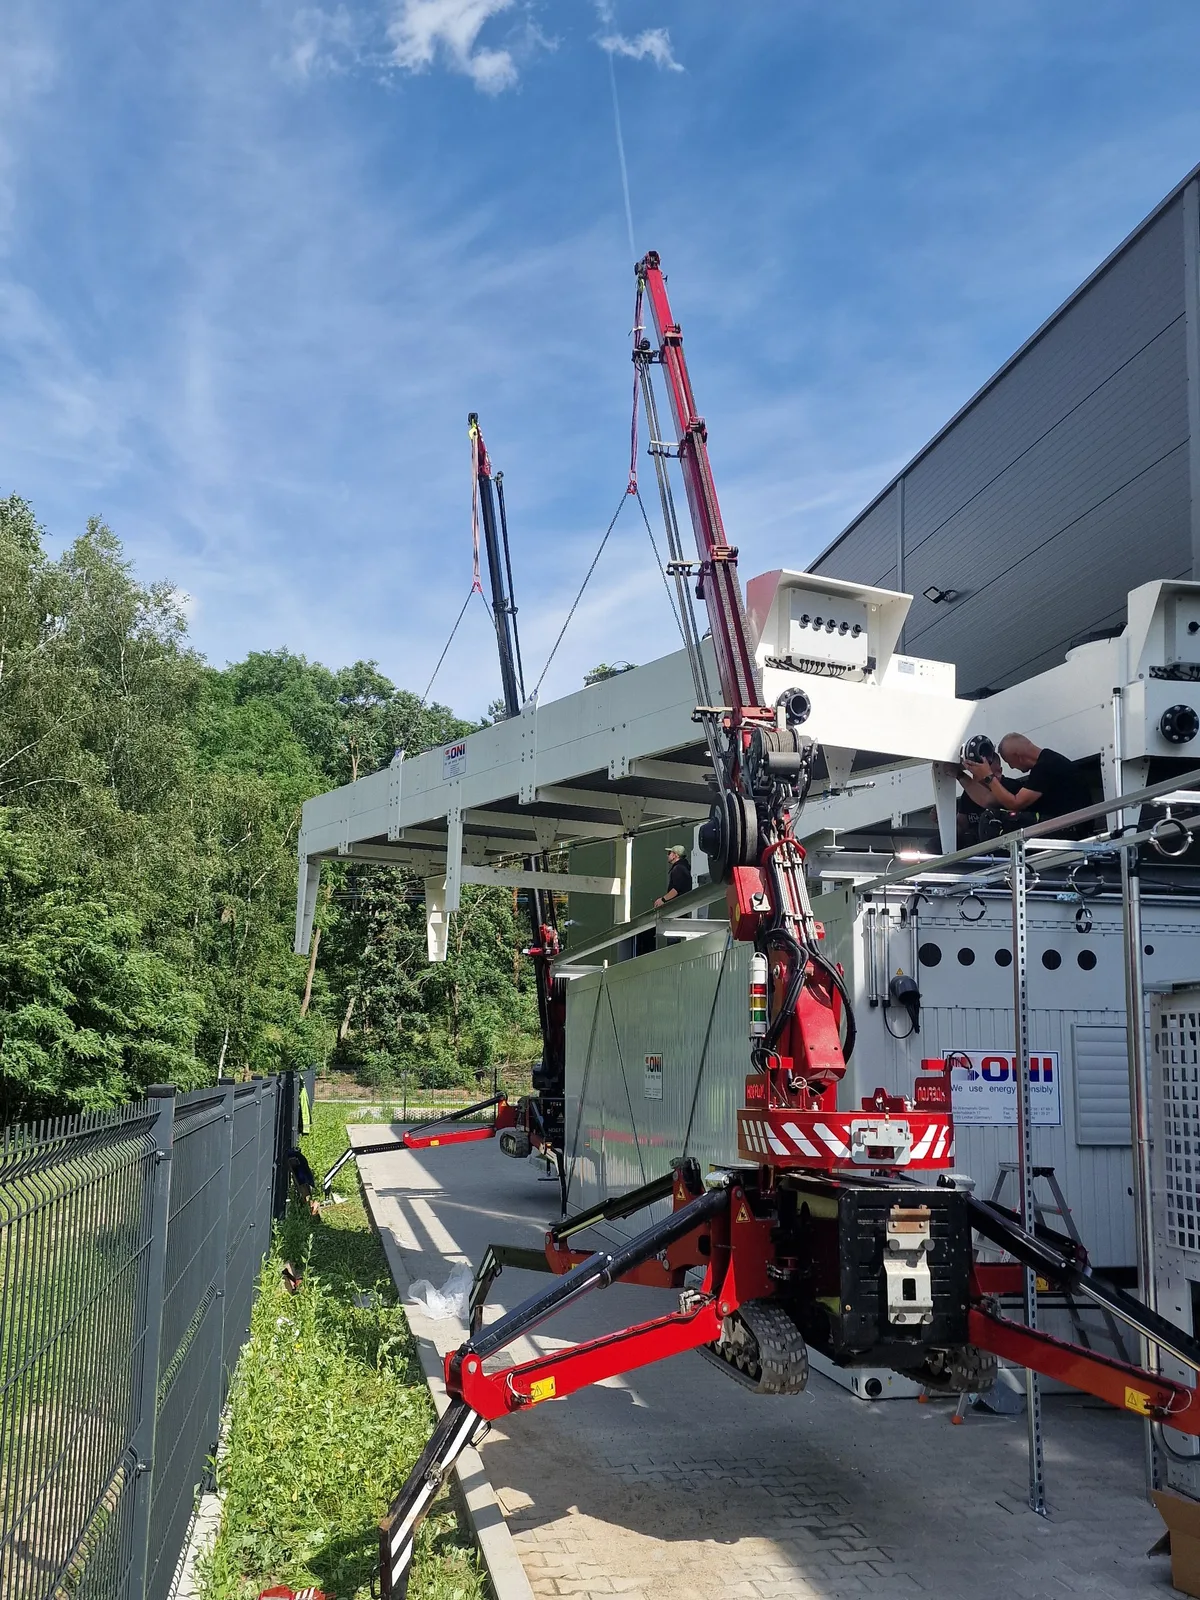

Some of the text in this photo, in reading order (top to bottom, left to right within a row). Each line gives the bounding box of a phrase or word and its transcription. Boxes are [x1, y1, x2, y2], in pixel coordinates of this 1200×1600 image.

[450, 743, 466, 760] ONI
[649, 1056, 662, 1073] ONI
[981, 1056, 1053, 1083] ONI
[951, 1084, 1054, 1095] We use energy nsibly
